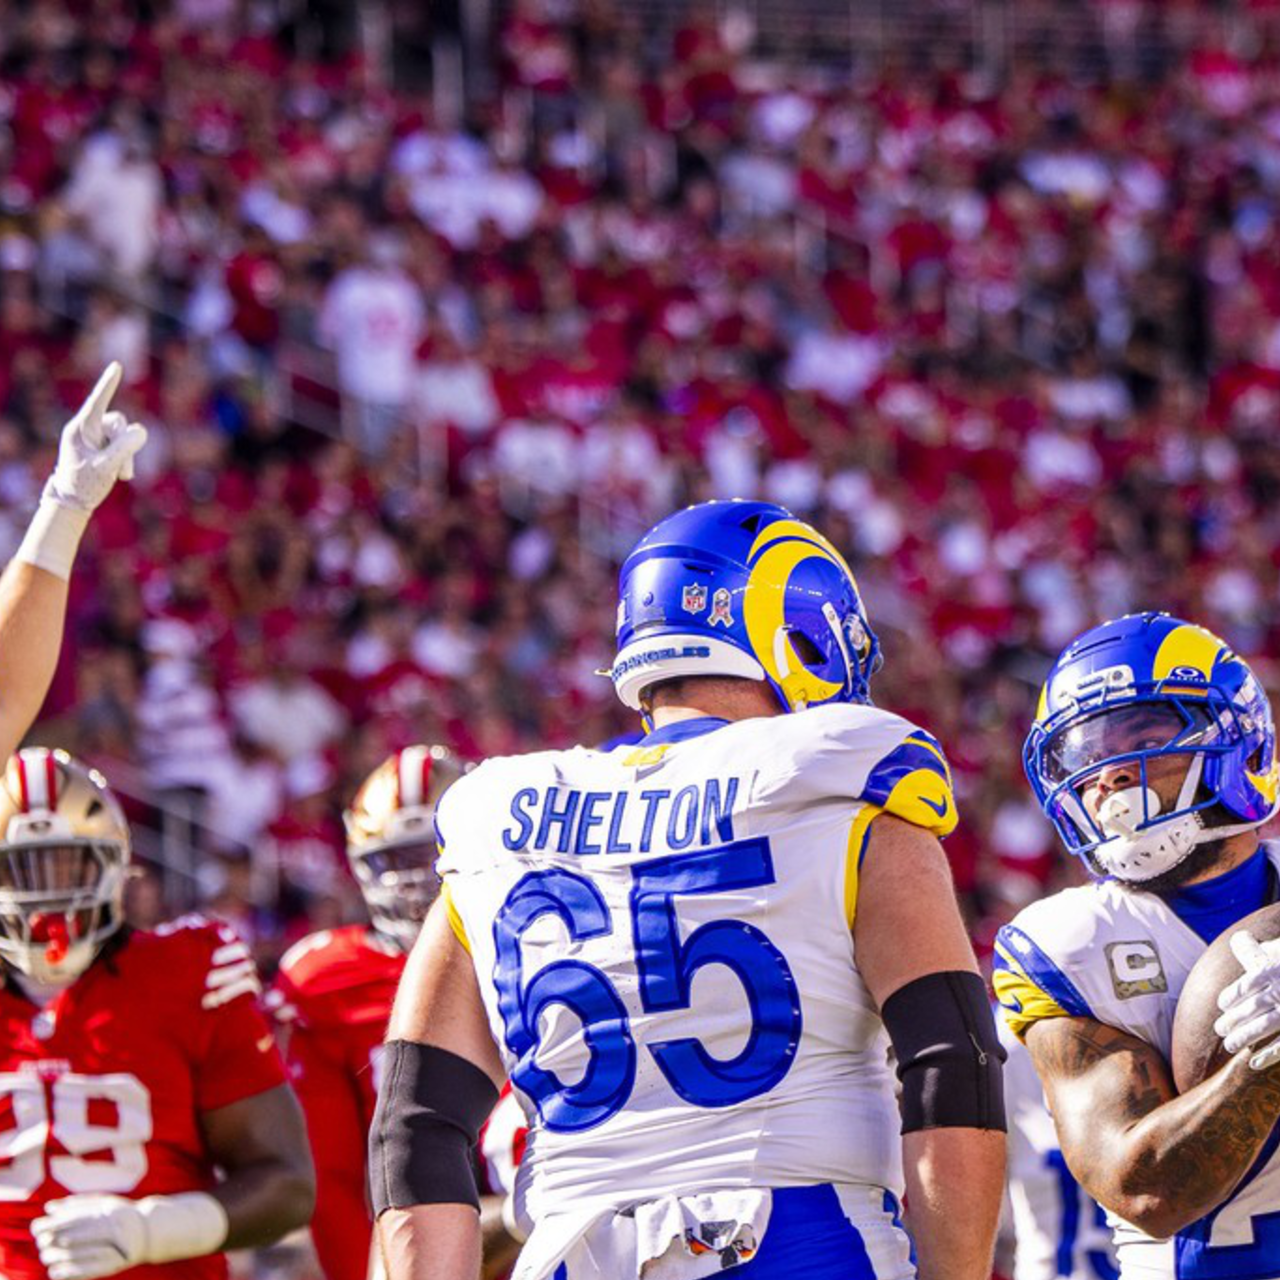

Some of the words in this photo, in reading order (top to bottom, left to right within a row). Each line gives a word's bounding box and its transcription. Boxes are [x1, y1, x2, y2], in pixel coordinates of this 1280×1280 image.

[502, 778, 739, 855] SHELTON
[492, 836, 803, 1133] 65
[1112, 943, 1162, 982] C
